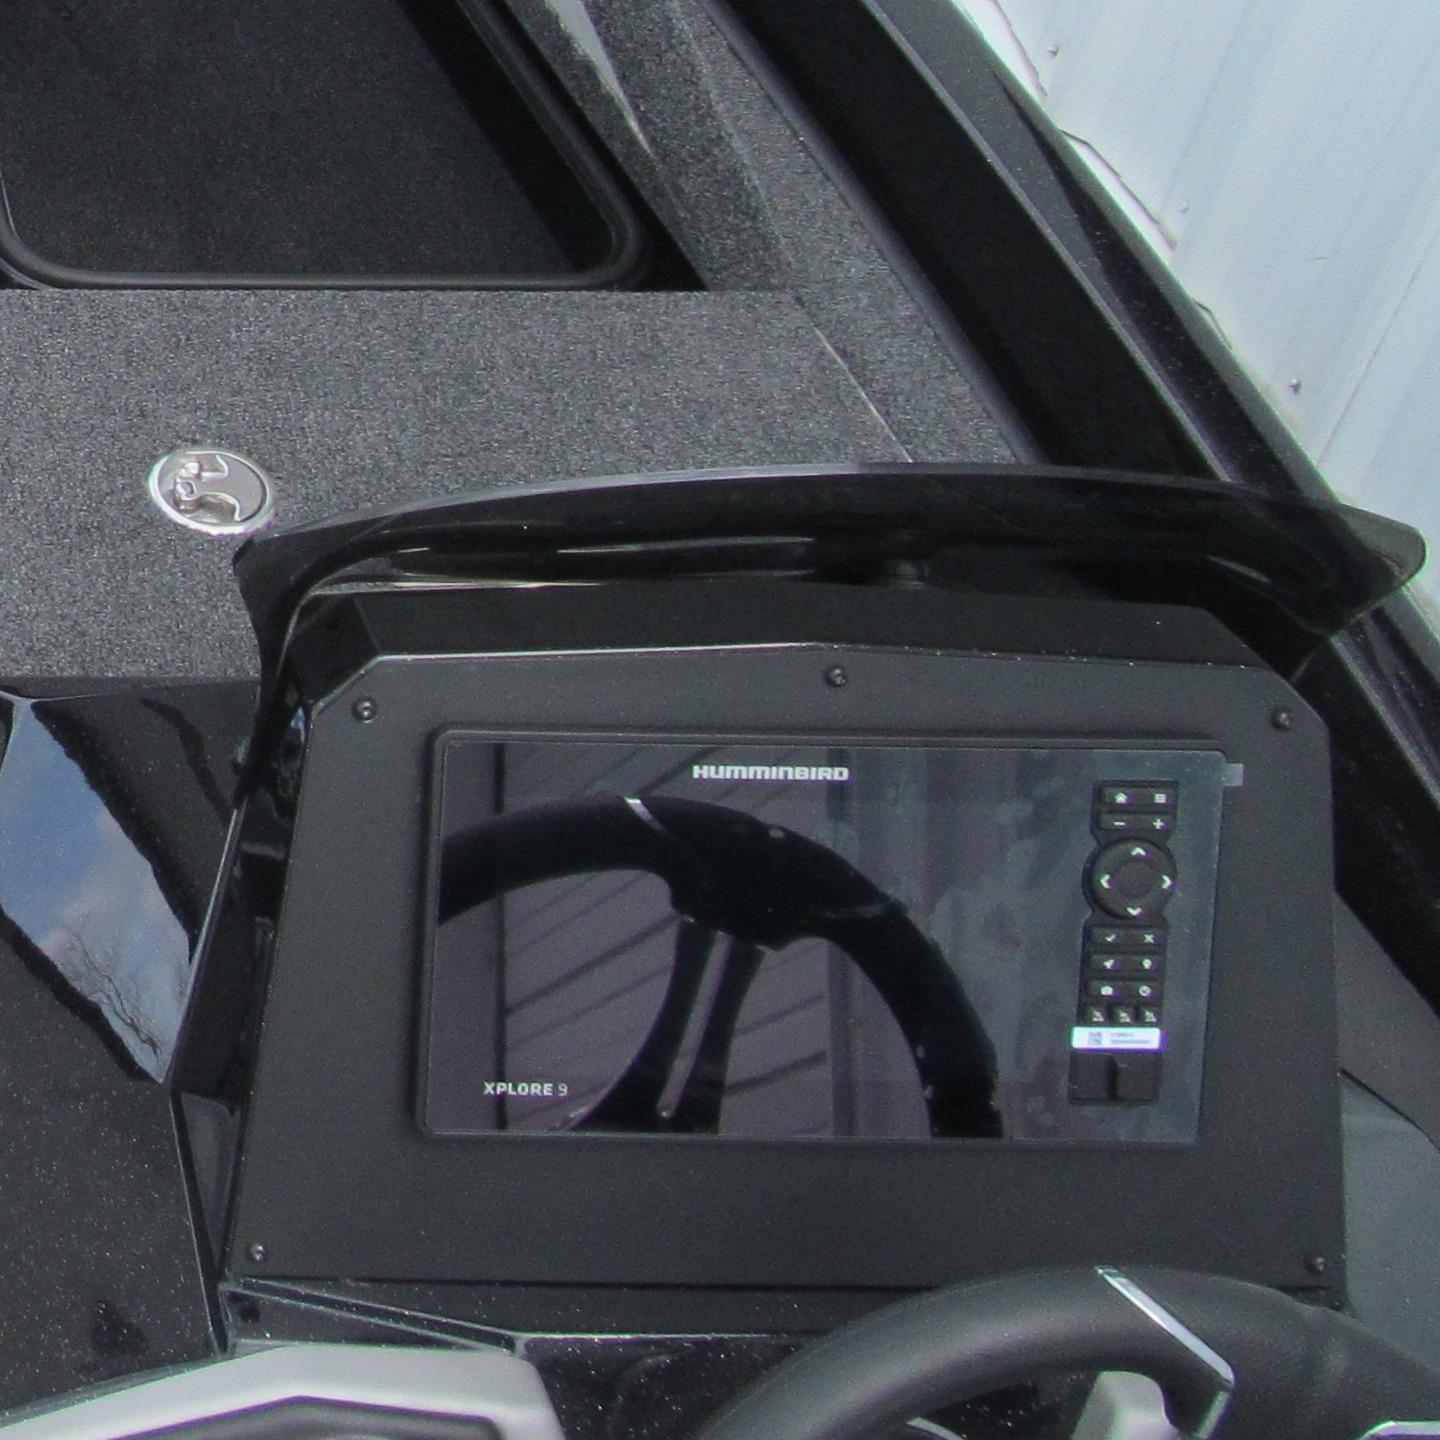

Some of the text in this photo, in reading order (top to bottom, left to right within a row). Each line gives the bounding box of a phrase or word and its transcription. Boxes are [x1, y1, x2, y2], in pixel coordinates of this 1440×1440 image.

[692, 764, 849, 781] HUMMINBIRD
[483, 1081, 568, 1097] XPLORE 9
